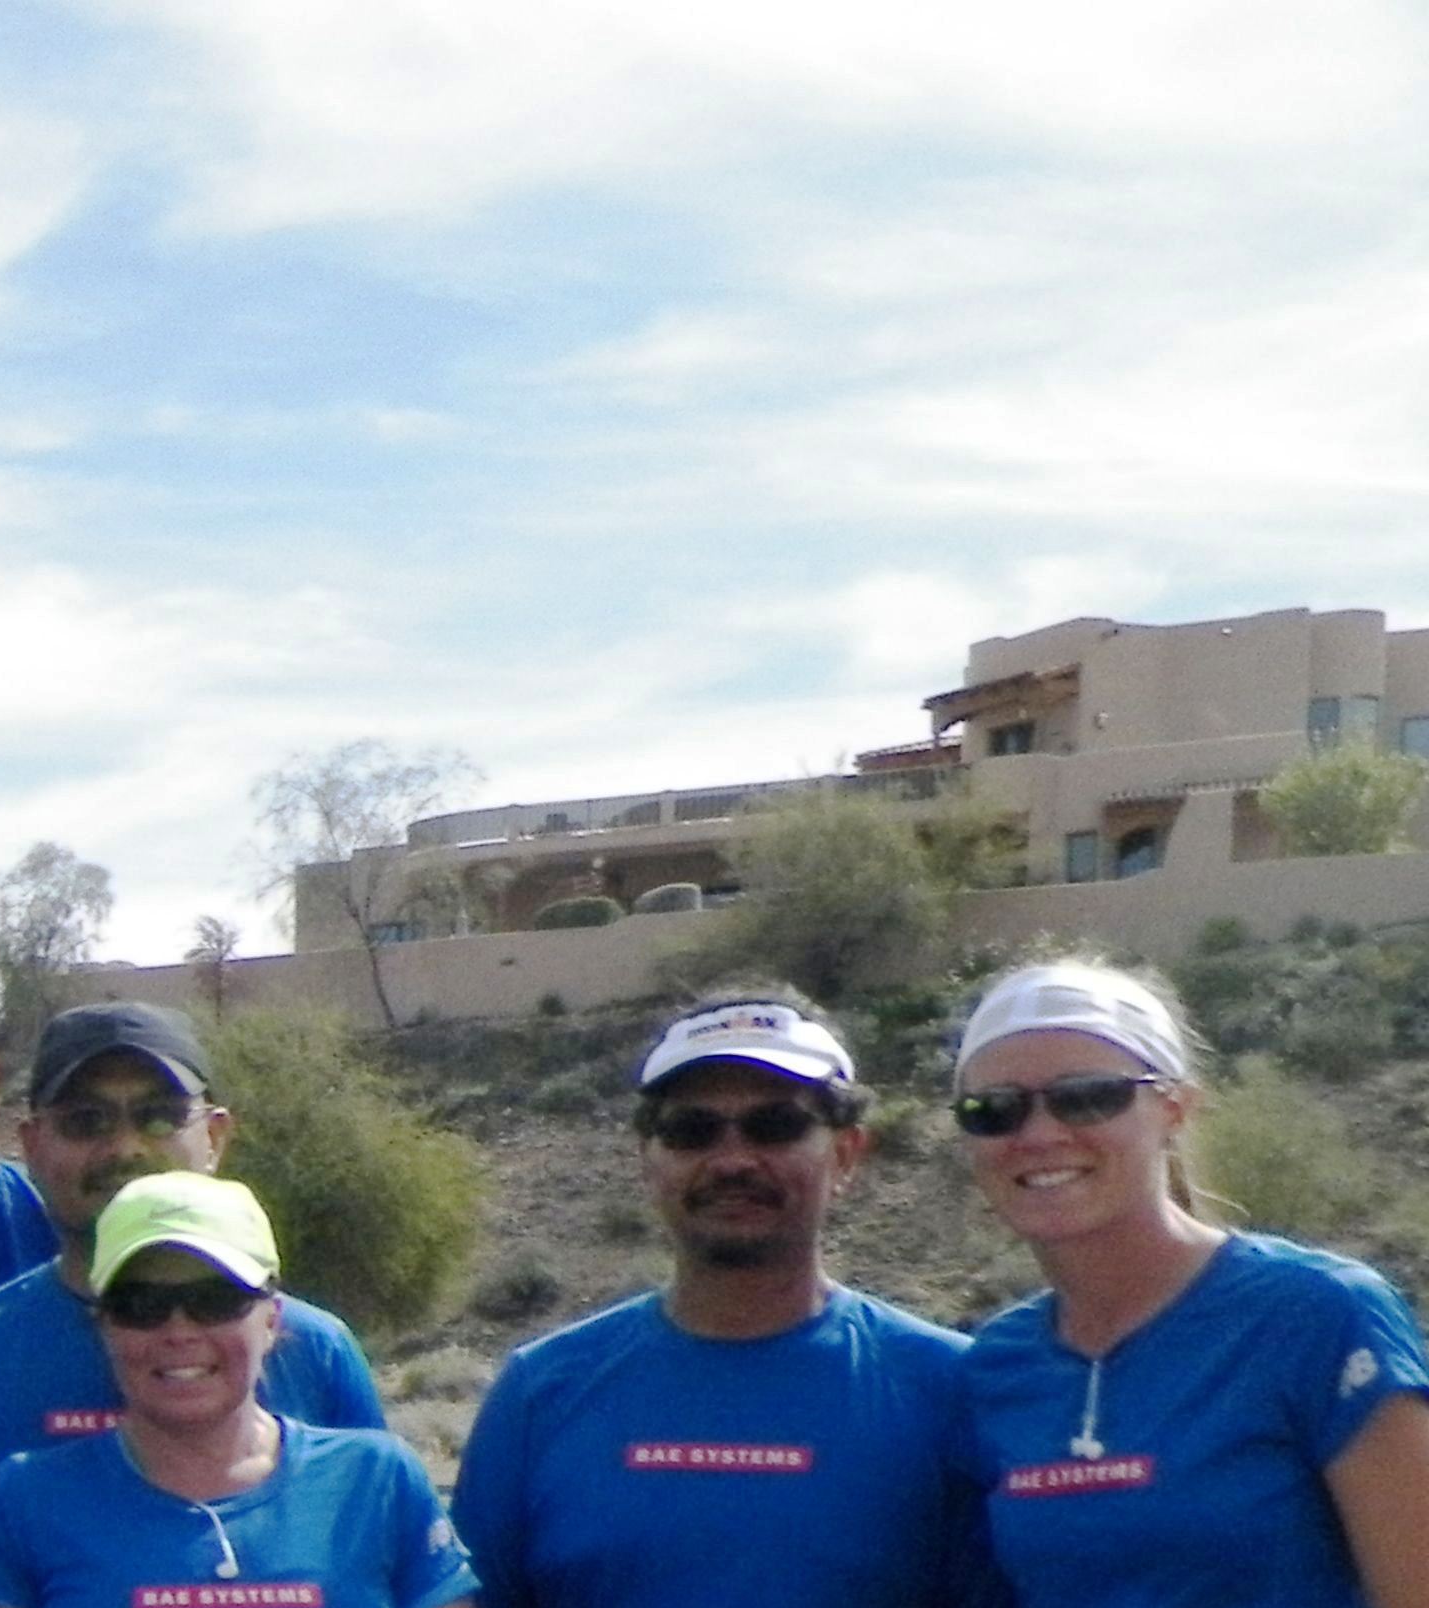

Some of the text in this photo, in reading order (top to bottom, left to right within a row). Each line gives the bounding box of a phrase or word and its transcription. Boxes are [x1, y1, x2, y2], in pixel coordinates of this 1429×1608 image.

[634, 1447, 803, 1467] BAE SYSTEMS
[1046, 1461, 1144, 1487] SYSTEMS
[143, 1587, 313, 1607] BAE SYSTEMS
